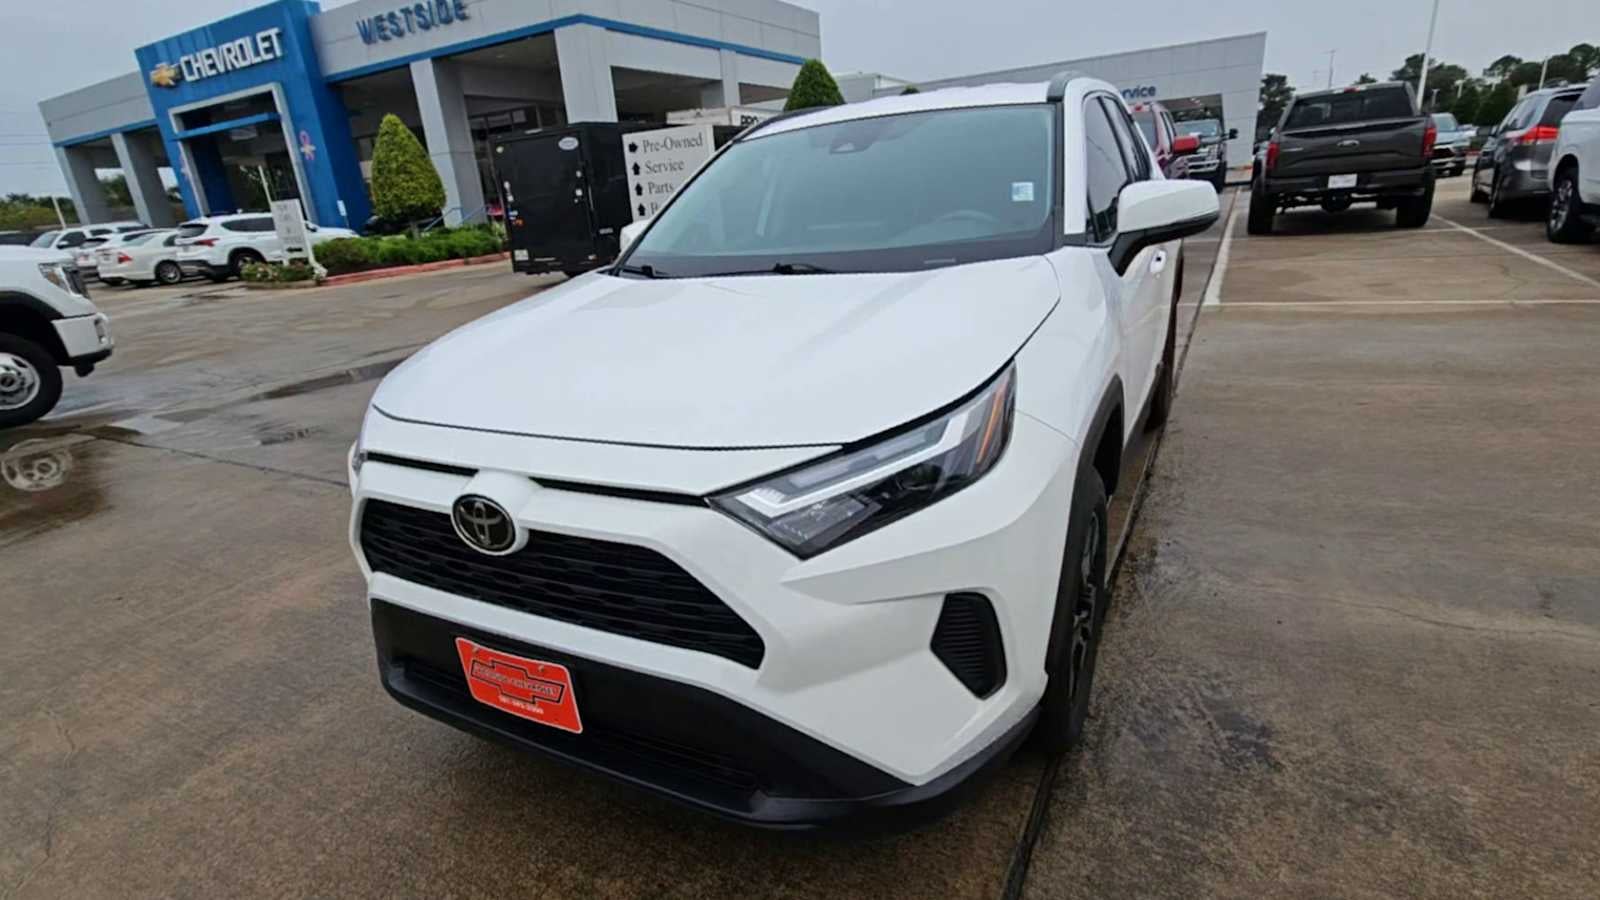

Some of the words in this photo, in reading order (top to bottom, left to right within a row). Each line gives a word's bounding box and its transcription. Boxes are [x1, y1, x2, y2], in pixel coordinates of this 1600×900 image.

[356, 0, 470, 45] WESTSIDE
[180, 27, 283, 82] CHEVROLET
[642, 132, 703, 153] Pre-Owned
[644, 159, 685, 174] Service
[647, 182, 674, 194] Parts
